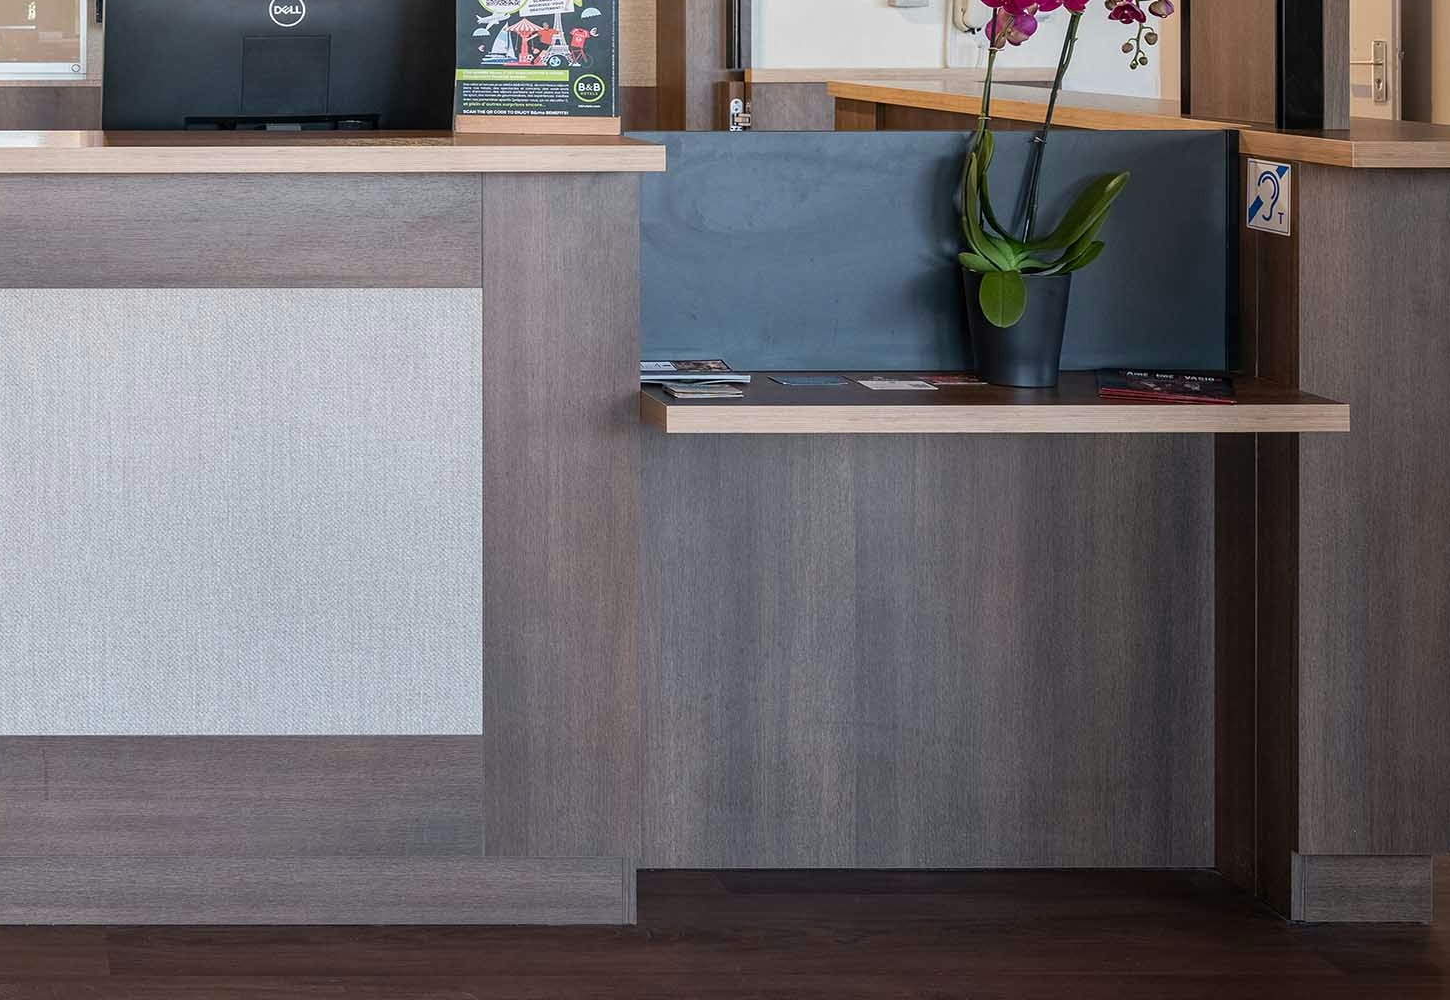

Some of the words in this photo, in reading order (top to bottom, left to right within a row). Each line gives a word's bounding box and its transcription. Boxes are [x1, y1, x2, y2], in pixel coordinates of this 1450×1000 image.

[273, 5, 302, 15] DELL
[578, 82, 601, 92] B&B
[1277, 211, 1285, 225] T
